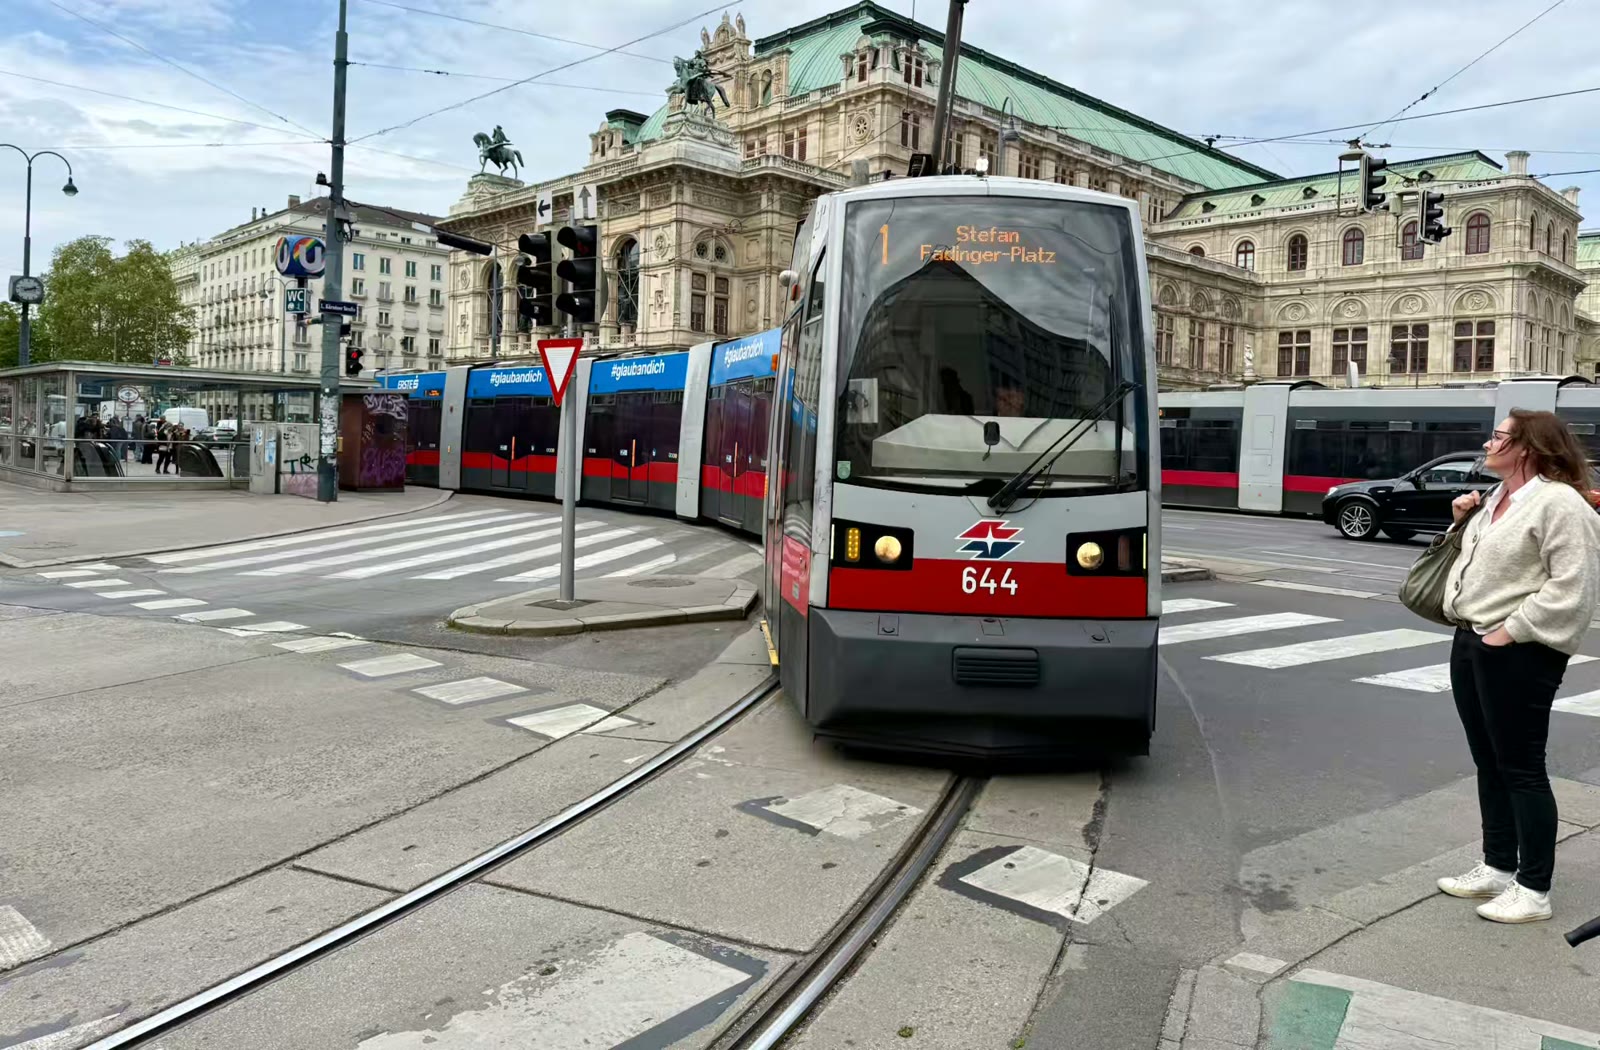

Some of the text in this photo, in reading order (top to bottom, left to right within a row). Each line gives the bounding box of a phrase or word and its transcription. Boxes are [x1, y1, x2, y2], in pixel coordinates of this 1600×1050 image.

[879, 223, 889, 265] 1
[956, 225, 1020, 243] Stefan
[299, 245, 323, 273] U
[919, 244, 1057, 265] Fadinger-Platz
[287, 290, 304, 302] WC
[724, 338, 764, 368] #glaubandich
[490, 369, 543, 387] #glaubandich
[610, 359, 666, 381] #glaubandich
[961, 566, 1019, 596] 644
